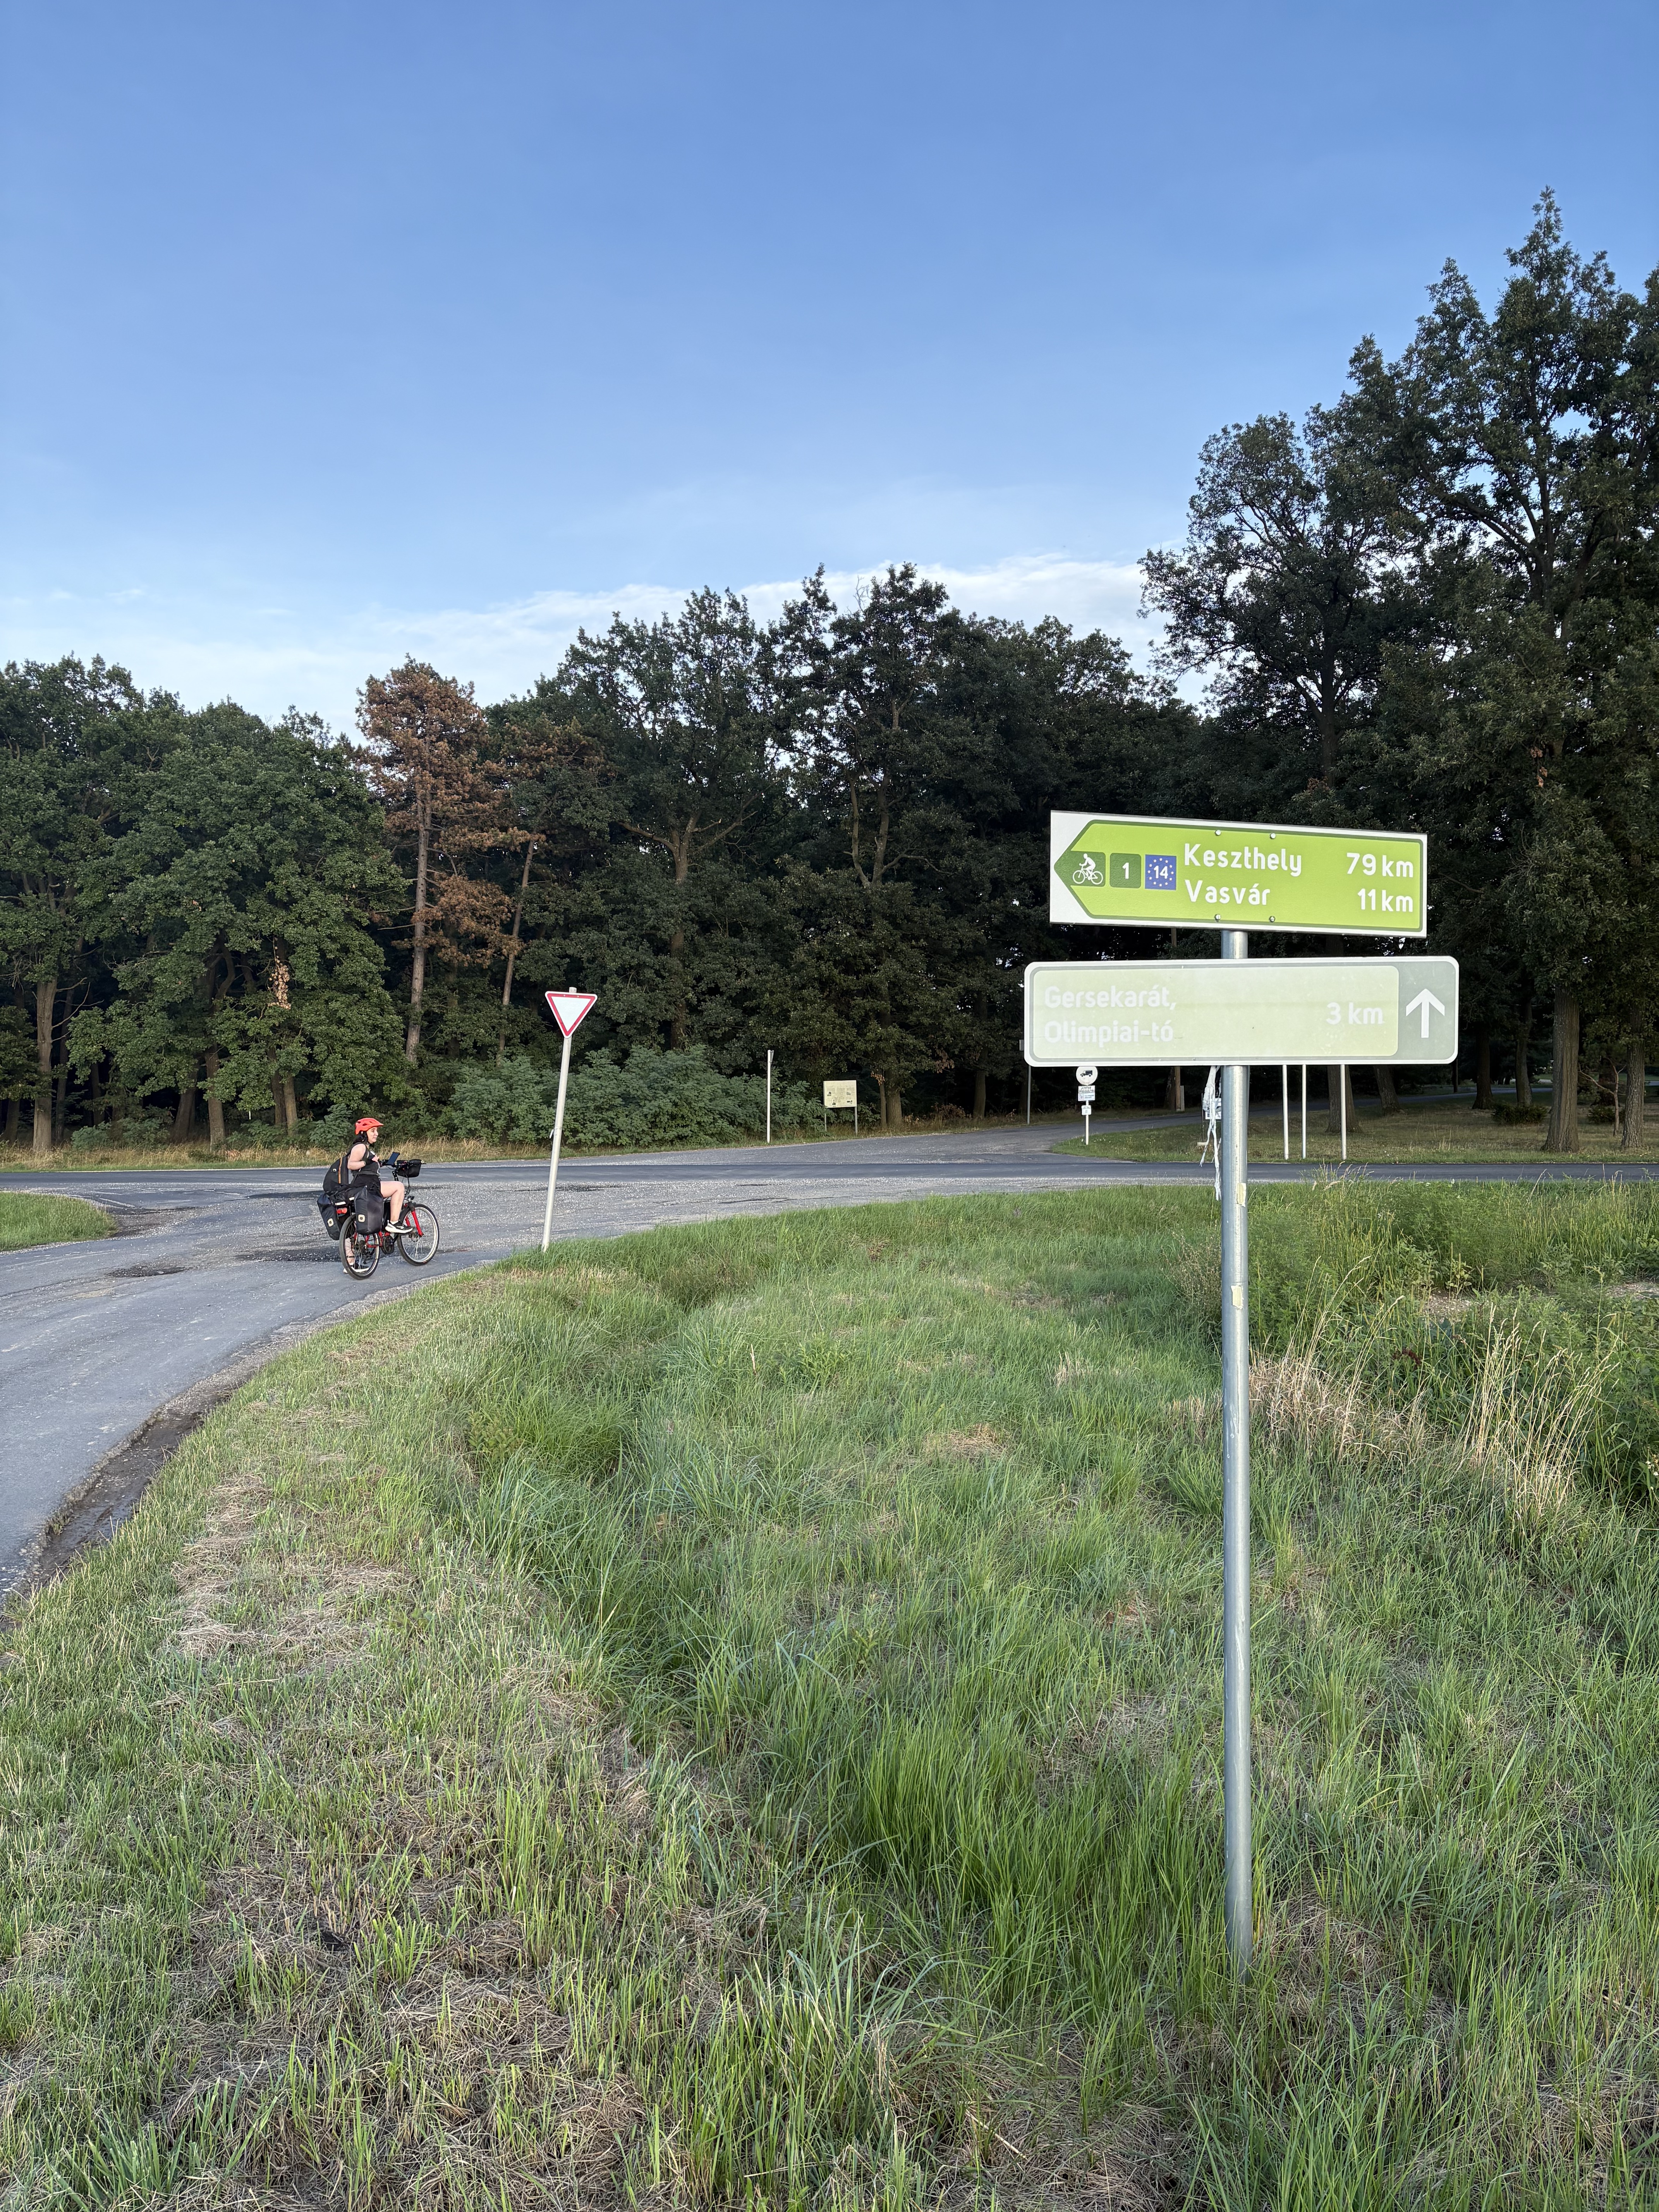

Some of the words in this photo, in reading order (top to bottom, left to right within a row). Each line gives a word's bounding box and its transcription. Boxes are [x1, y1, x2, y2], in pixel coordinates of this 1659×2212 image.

[1122, 862, 1129, 879] 1
[1153, 865, 1168, 879] 14
[1185, 843, 1302, 877] Keszthely
[1346, 852, 1376, 876] 79
[1382, 855, 1413, 878] km
[1185, 879, 1271, 905] Vasvár
[1357, 888, 1376, 910] 11
[1381, 890, 1413, 912] km
[1044, 984, 1176, 1010] Gersekarát,
[1326, 1002, 1341, 1025] 3
[1348, 1002, 1383, 1024] km
[1044, 1019, 1174, 1048] Olimpiai-tó
